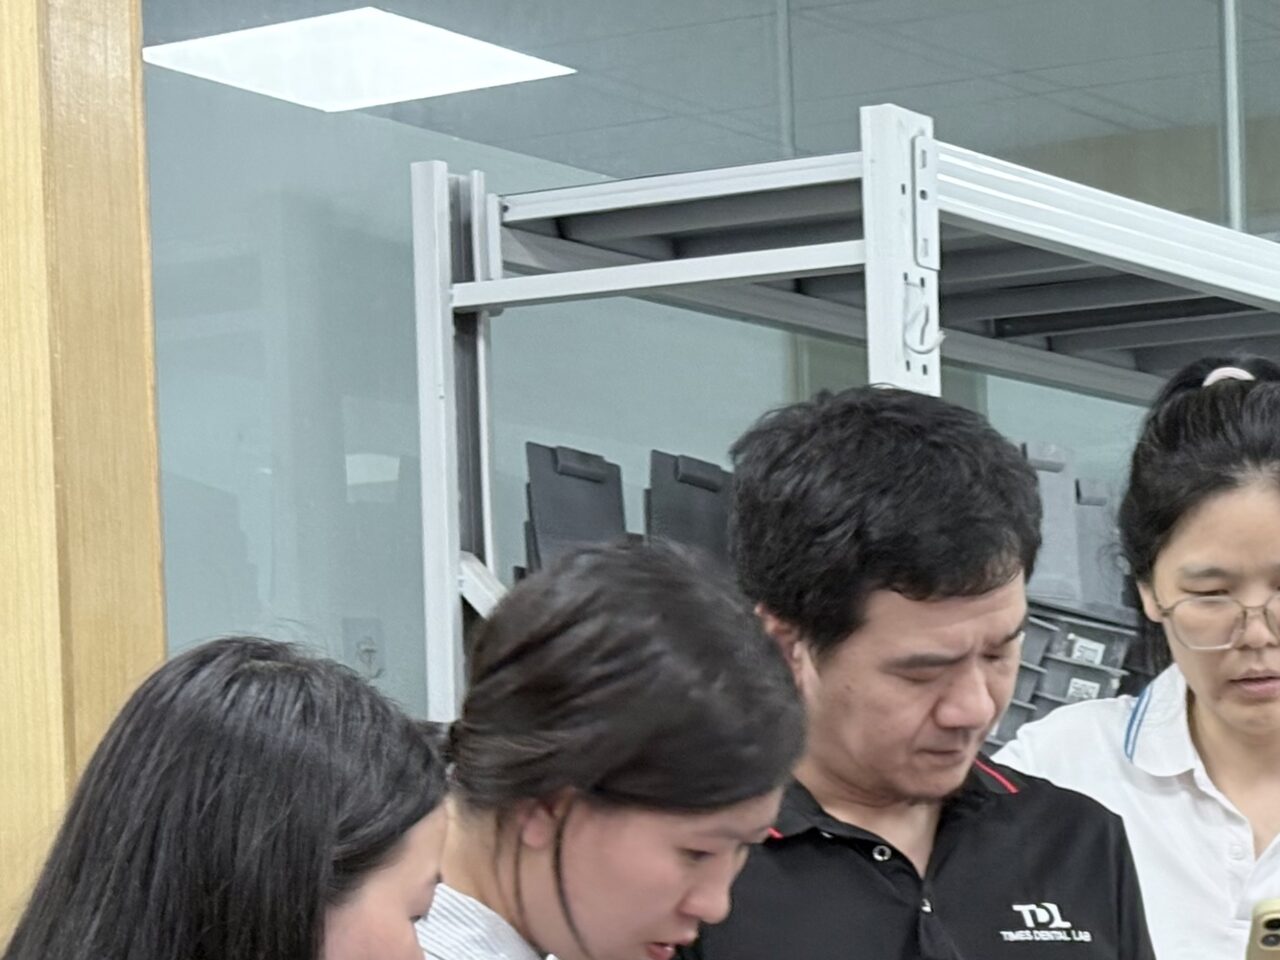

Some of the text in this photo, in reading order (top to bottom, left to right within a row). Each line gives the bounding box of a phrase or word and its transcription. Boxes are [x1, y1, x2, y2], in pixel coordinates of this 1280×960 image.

[1000, 929, 1093, 943] TIMES DENTAL LAB
